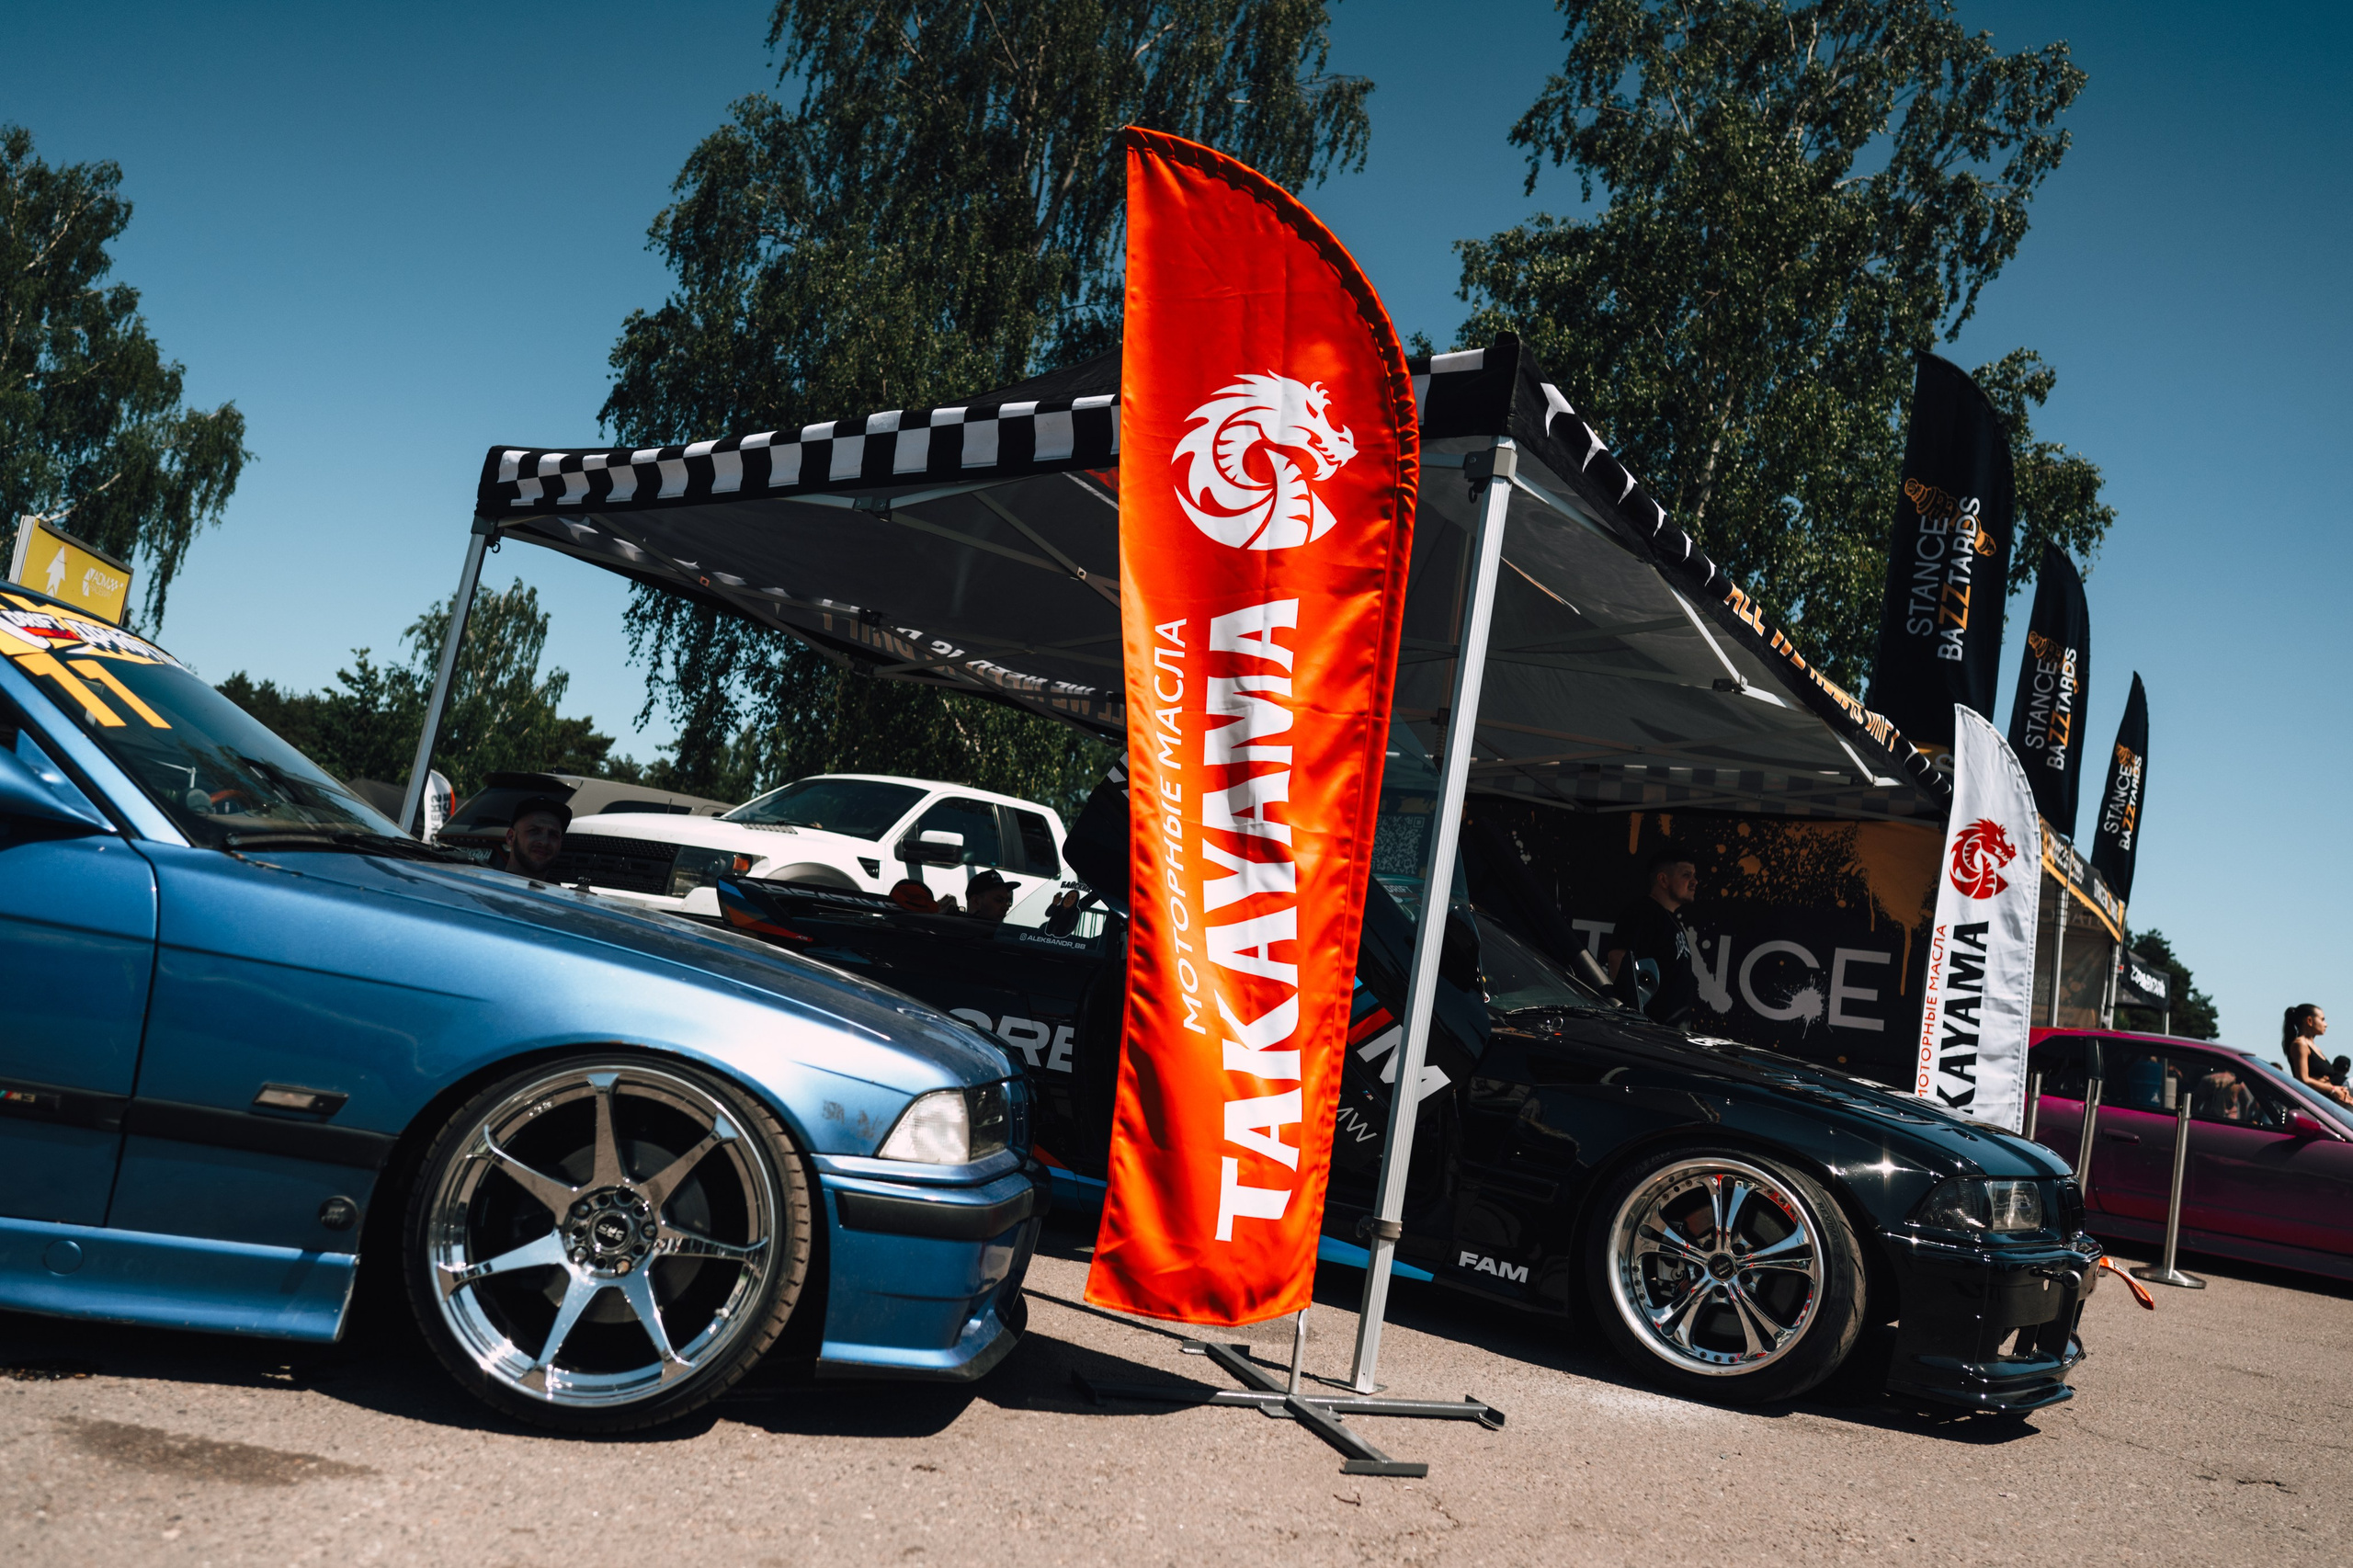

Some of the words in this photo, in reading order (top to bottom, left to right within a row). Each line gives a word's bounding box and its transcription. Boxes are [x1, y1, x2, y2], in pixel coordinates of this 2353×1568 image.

[2, 609, 65, 631] DRIFT
[1906, 515, 1949, 636] STANCE
[1937, 496, 1981, 662] BAZZTARDS
[14, 652, 172, 729] 11
[1154, 618, 1188, 770] МАСЛА
[2025, 659, 2058, 749] STANCE
[2046, 647, 2077, 771] BAZZTARDS
[2103, 764, 2132, 834] STANCE
[2119, 755, 2142, 851] BAZZTARDS
[1160, 775, 1206, 1035] МОТОРНЫЕ
[1202, 597, 1302, 1242] TAKAYAMA
[1382, 884, 1414, 894] DRIFT
[1572, 918, 1892, 1031] TNCE
[1928, 925, 1947, 991] МАСЛА
[1458, 1250, 1529, 1284] FAM
